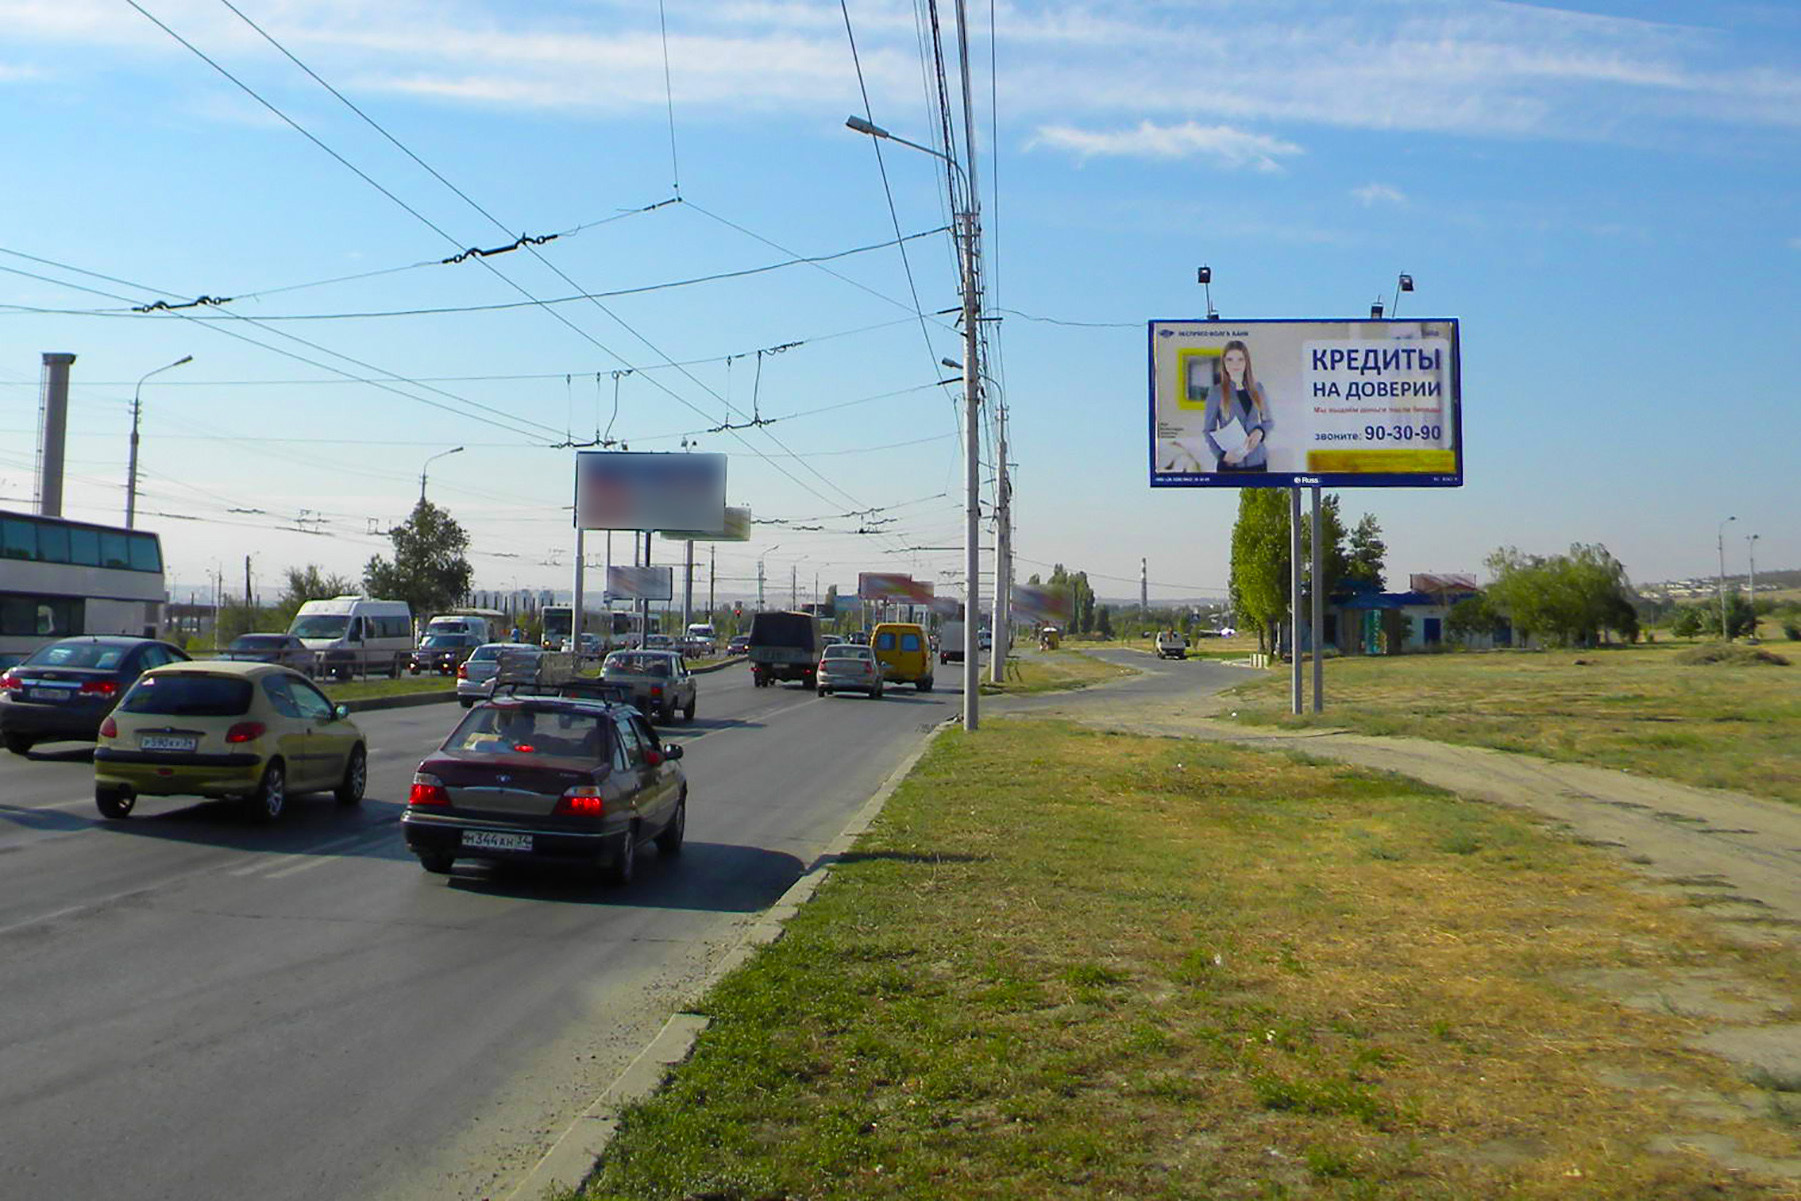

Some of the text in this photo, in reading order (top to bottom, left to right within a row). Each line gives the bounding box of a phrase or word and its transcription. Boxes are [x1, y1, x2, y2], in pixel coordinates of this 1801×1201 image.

[1312, 348, 1441, 376] КРЕДИТЫ
[1313, 381, 1441, 401] НА ДОВЕРИИ
[1315, 425, 1441, 441] звоните: 90-30-90
